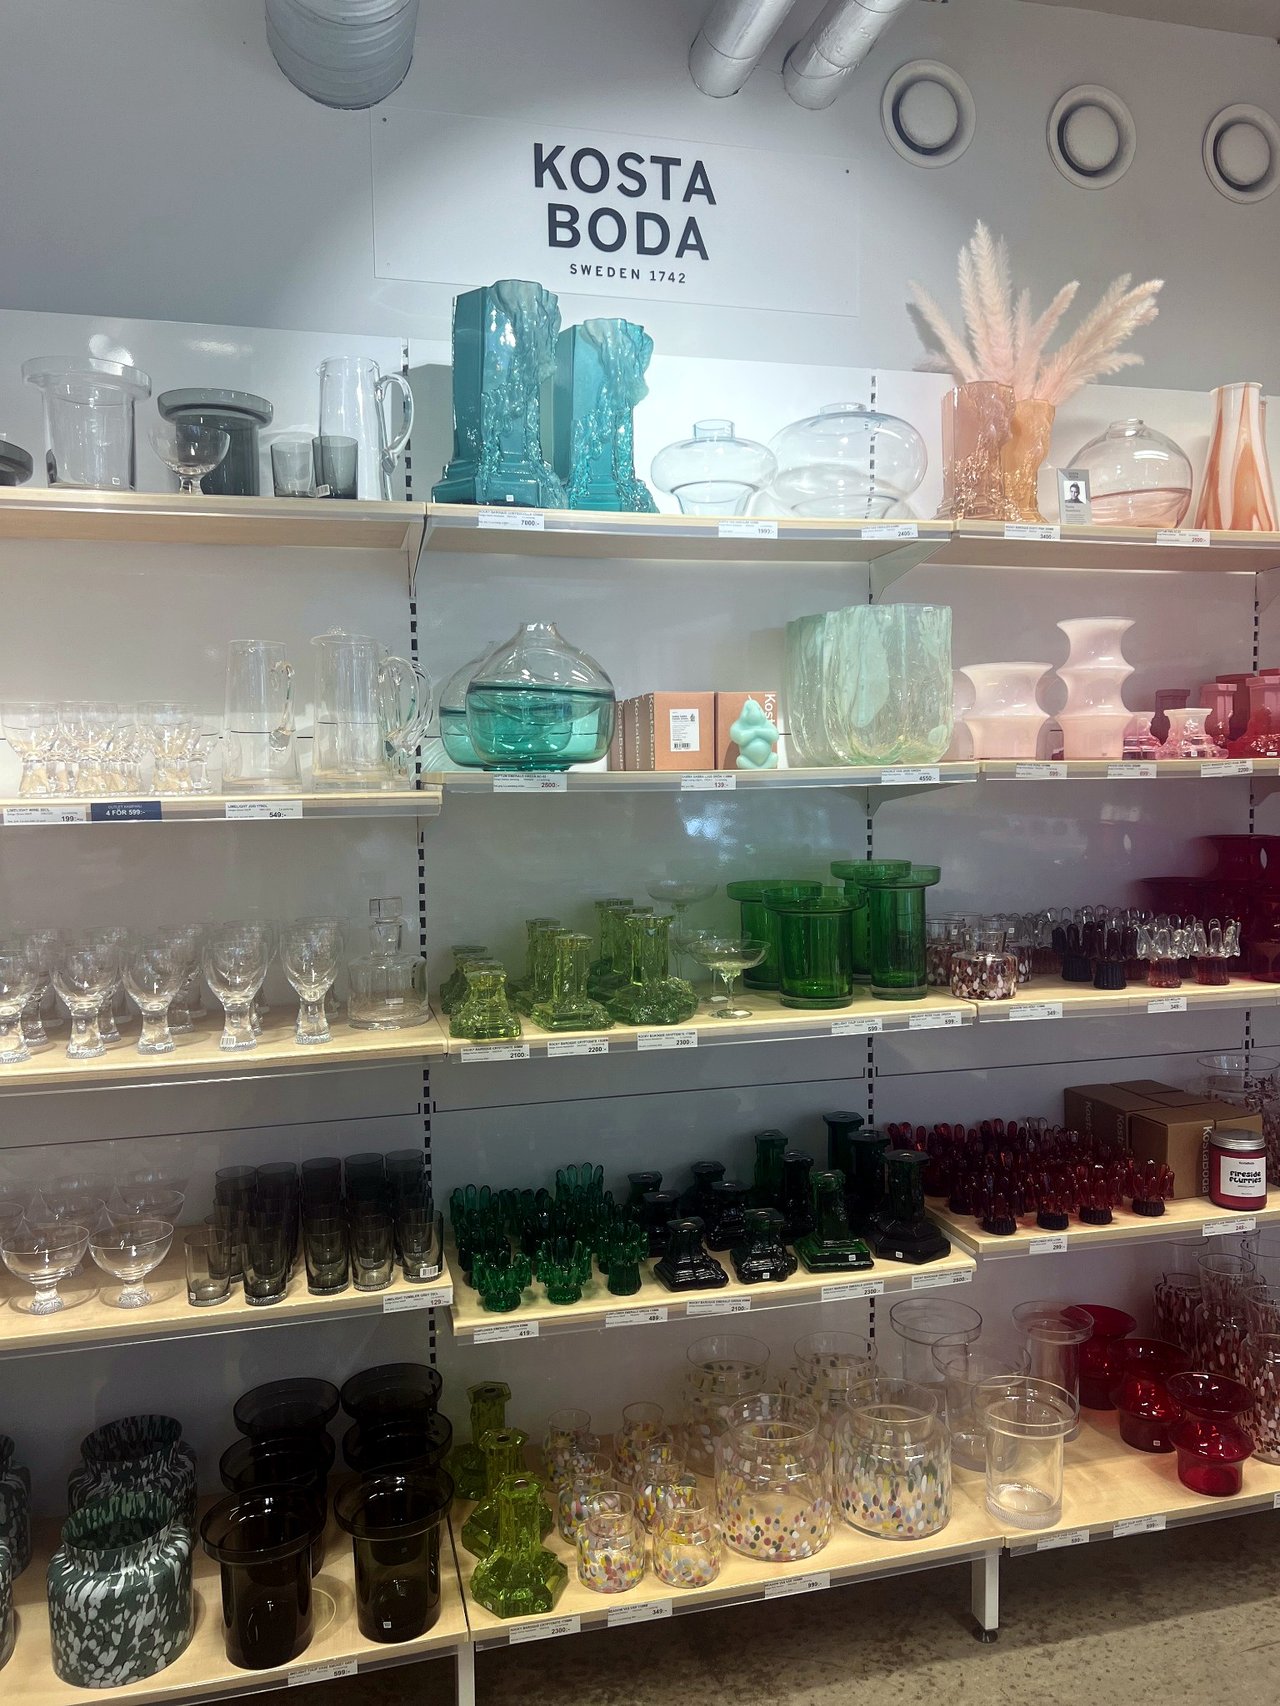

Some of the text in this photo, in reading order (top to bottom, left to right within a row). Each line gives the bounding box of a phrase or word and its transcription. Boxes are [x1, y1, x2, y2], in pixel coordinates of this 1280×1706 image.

[533, 142, 717, 206] KOSTA
[547, 202, 710, 261] BODA
[569, 263, 686, 284] SWEDEN 1742
